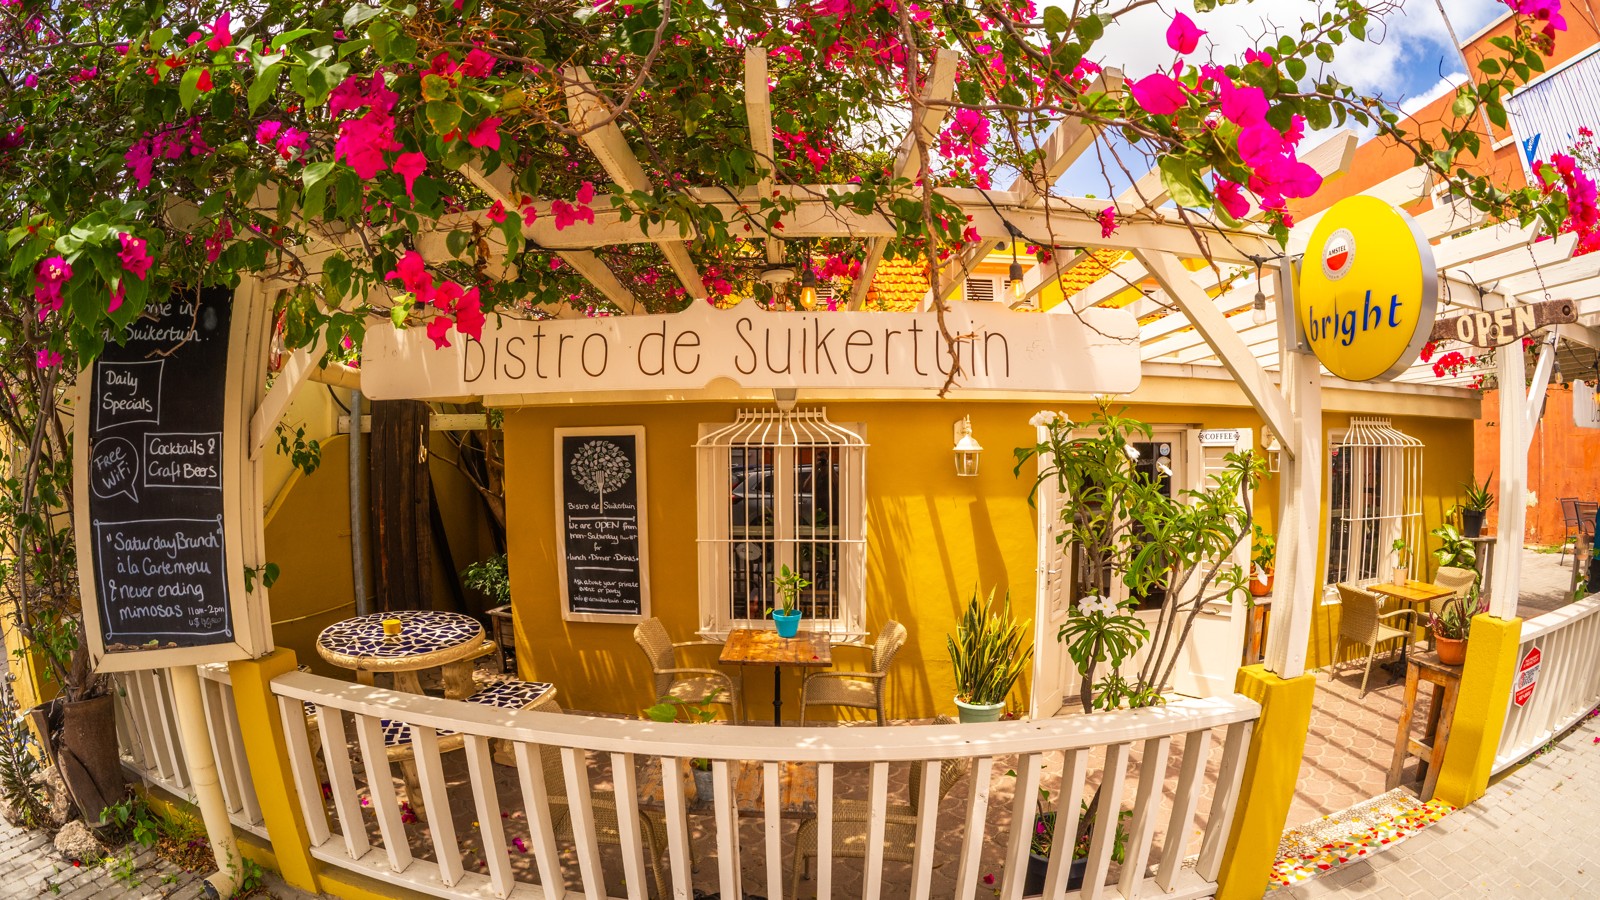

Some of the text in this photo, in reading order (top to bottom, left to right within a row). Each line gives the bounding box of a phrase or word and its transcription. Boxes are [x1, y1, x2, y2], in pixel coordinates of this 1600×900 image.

[1328, 245, 1347, 256] AMSTEL
[1309, 290, 1403, 347] bright
[1456, 304, 1537, 348] OPEN
[637, 319, 700, 376] de
[734, 315, 1010, 378] Suikertuin
[105, 370, 138, 396] Daily
[102, 392, 153, 415] Specials
[149, 437, 205, 455] Cocktails
[1204, 432, 1234, 441] COFFEE
[148, 461, 217, 482] Craft Beers
[127, 554, 140, 575] la
[173, 560, 212, 576] menu
[119, 584, 154, 600] never
[157, 582, 205, 602] ending
[119, 604, 183, 621] mimosas
